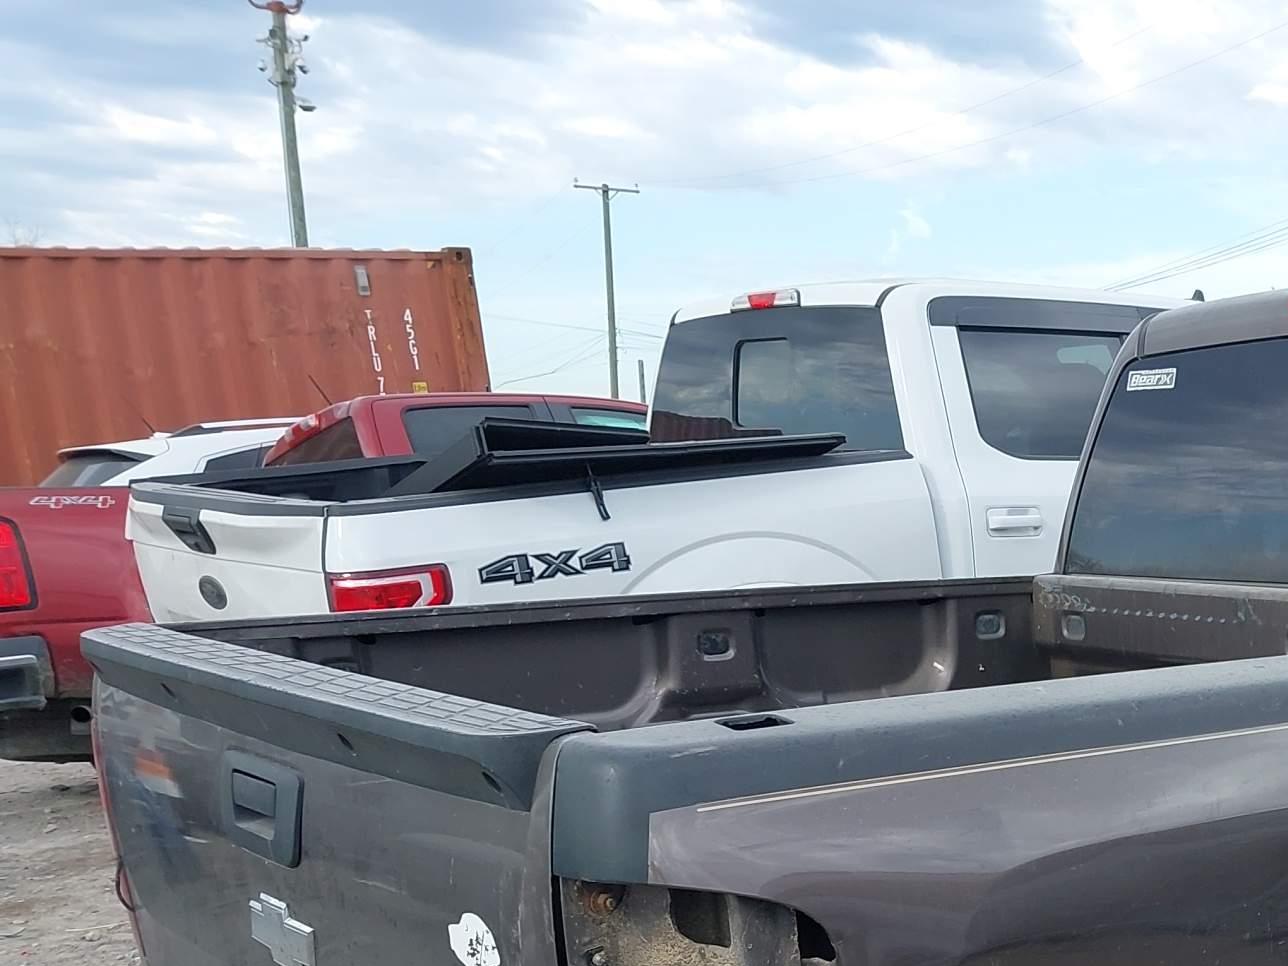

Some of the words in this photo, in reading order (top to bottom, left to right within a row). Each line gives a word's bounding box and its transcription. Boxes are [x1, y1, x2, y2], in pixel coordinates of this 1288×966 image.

[364, 309, 382, 372] TRLU
[377, 377, 386, 395] 7
[403, 308, 420, 371] 45G1
